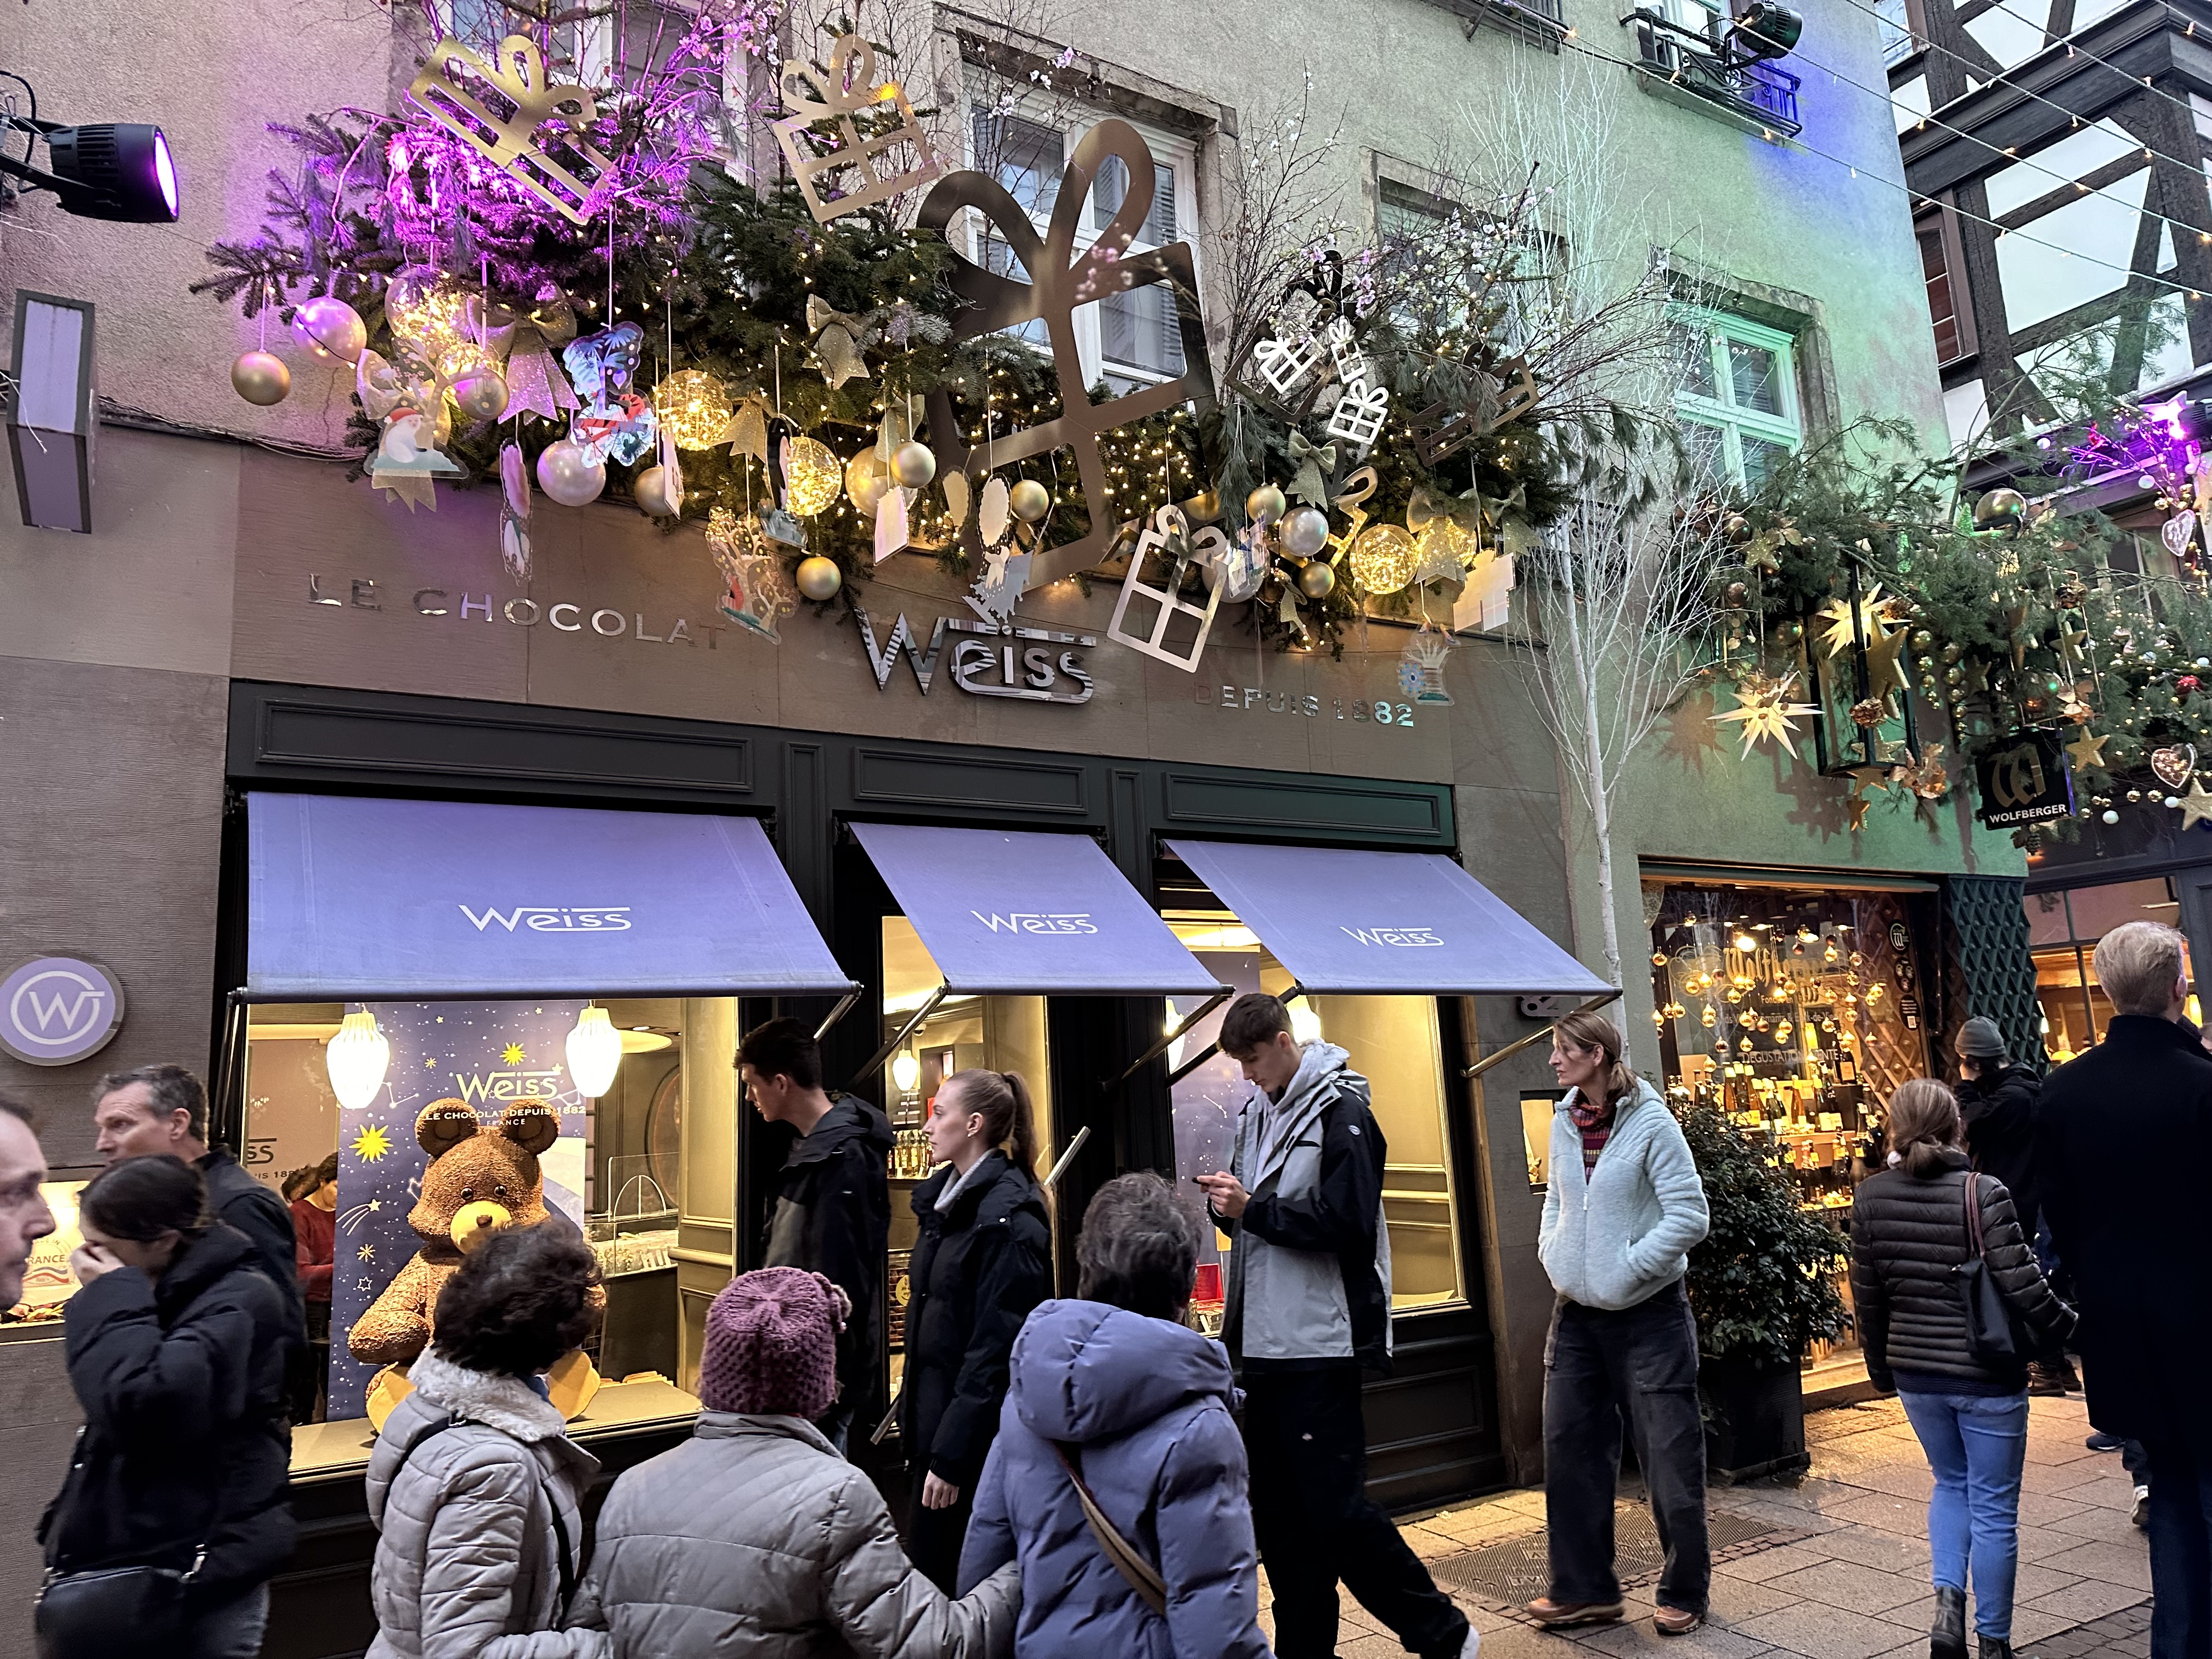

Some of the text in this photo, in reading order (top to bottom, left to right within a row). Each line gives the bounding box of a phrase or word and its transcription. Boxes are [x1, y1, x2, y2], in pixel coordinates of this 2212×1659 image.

[307, 573, 726, 650] LE CHOCOLAT
[853, 605, 1097, 704] Weiss
[1193, 681, 1414, 727] DEPUIS 1882
[1989, 804, 2067, 823] WOLFBERGER
[458, 904, 632, 933] Weiss
[970, 910, 1098, 934] Weiss
[1339, 926, 1444, 947] Weiss
[455, 1070, 561, 1103] Weiss
[444, 1109, 505, 1120] CHOCOLAT
[509, 1108, 551, 1117] DEPUIS
[557, 1105, 586, 1116] 1882
[487, 1118, 526, 1126] FRANCE
[27, 1254, 65, 1265] RANCE
